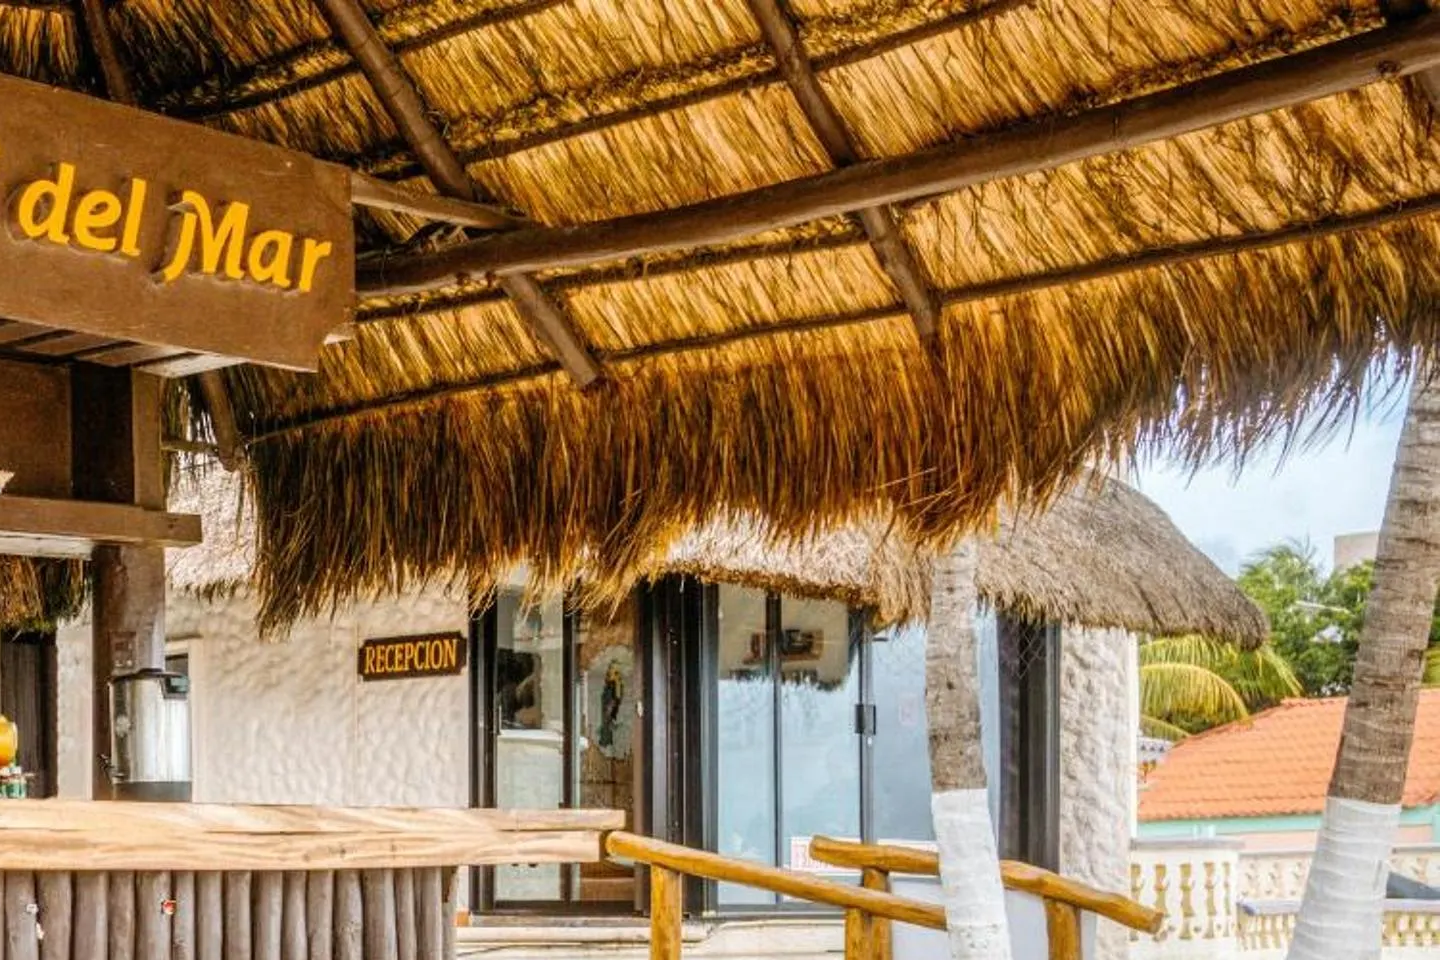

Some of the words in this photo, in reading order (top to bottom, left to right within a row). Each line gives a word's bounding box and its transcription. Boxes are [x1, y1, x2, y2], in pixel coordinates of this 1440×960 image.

[18, 162, 146, 257] del
[164, 190, 332, 293] Mar
[364, 639, 458, 674] RECEPCION
